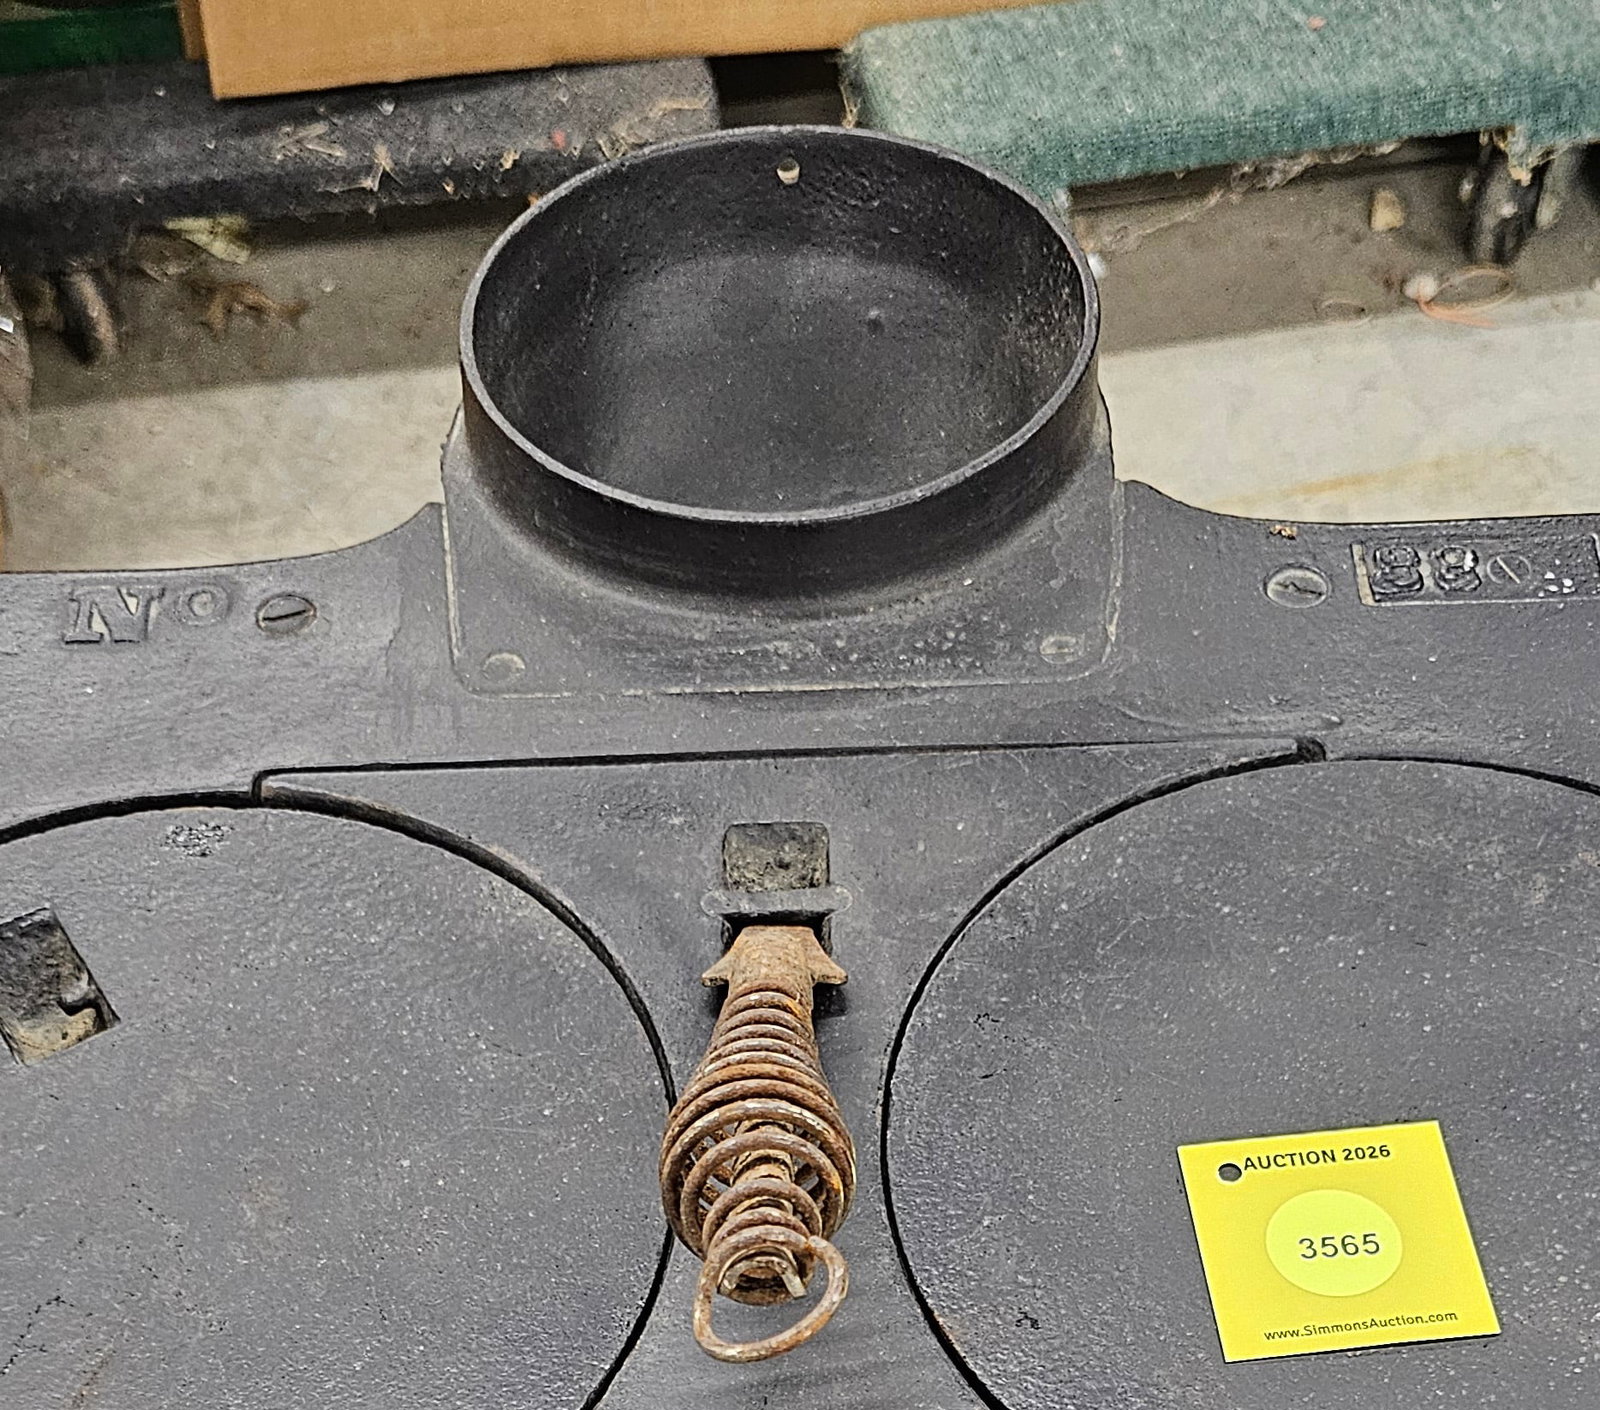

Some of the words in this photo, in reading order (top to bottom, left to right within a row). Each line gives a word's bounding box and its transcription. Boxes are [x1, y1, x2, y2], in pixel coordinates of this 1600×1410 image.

[1243, 1149, 1336, 1171] AUCTION
[1343, 1144, 1391, 1161] 2026
[1298, 1233, 1380, 1259] 3565
[1263, 1311, 1458, 1341] www.SimmonsAuction.com
